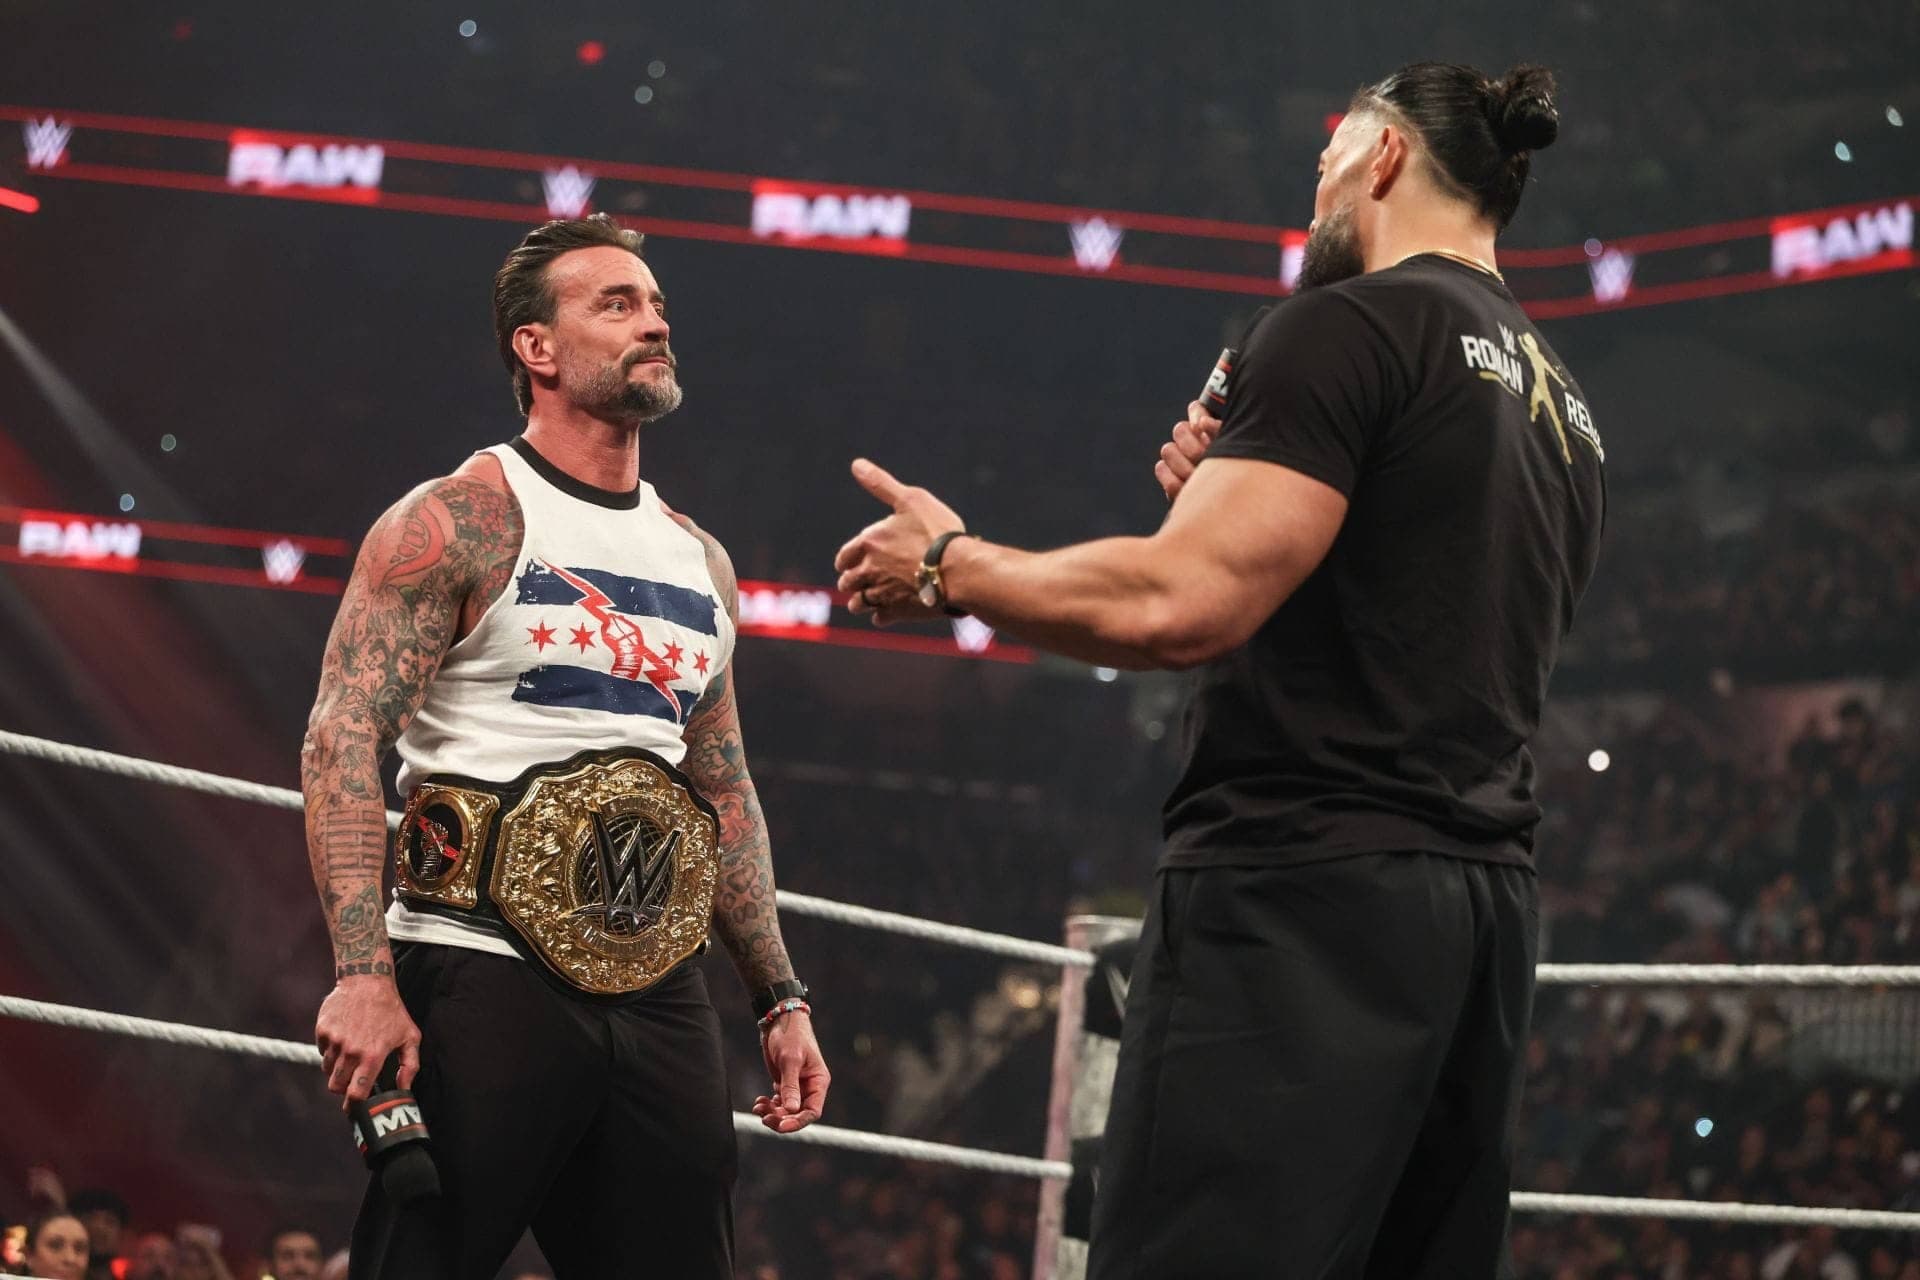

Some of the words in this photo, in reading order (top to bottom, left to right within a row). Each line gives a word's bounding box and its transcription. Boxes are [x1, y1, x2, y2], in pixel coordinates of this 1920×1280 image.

[228, 143, 385, 187] RAW
[751, 192, 911, 240] RAW
[1771, 203, 1915, 279] RAW
